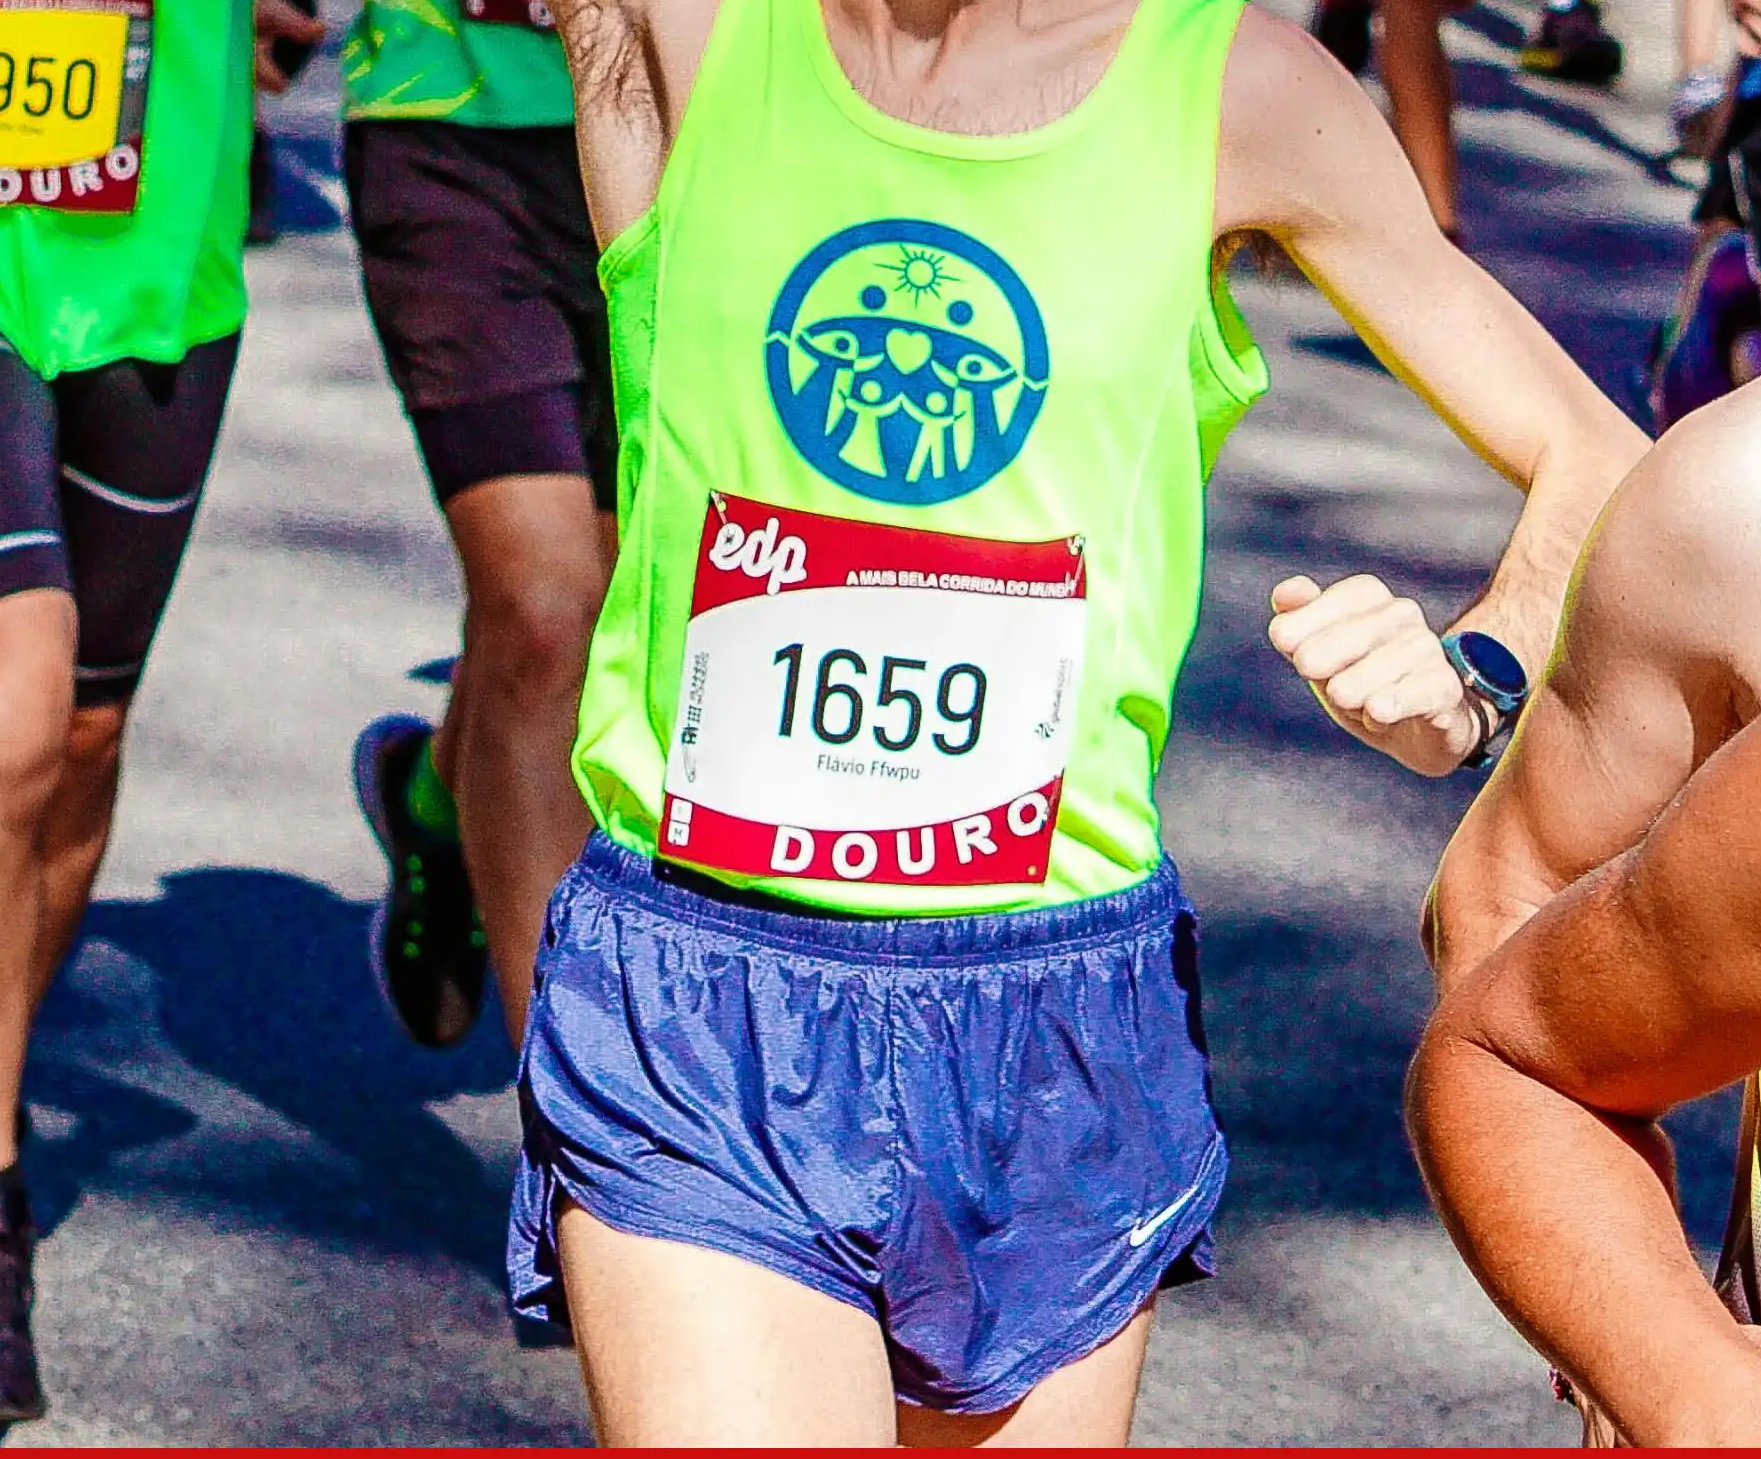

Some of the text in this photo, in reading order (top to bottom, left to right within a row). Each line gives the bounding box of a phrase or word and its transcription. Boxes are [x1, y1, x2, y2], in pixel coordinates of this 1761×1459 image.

[708, 517, 808, 597] edp
[773, 642, 988, 756] 1659
[769, 790, 1051, 880] DOURO
